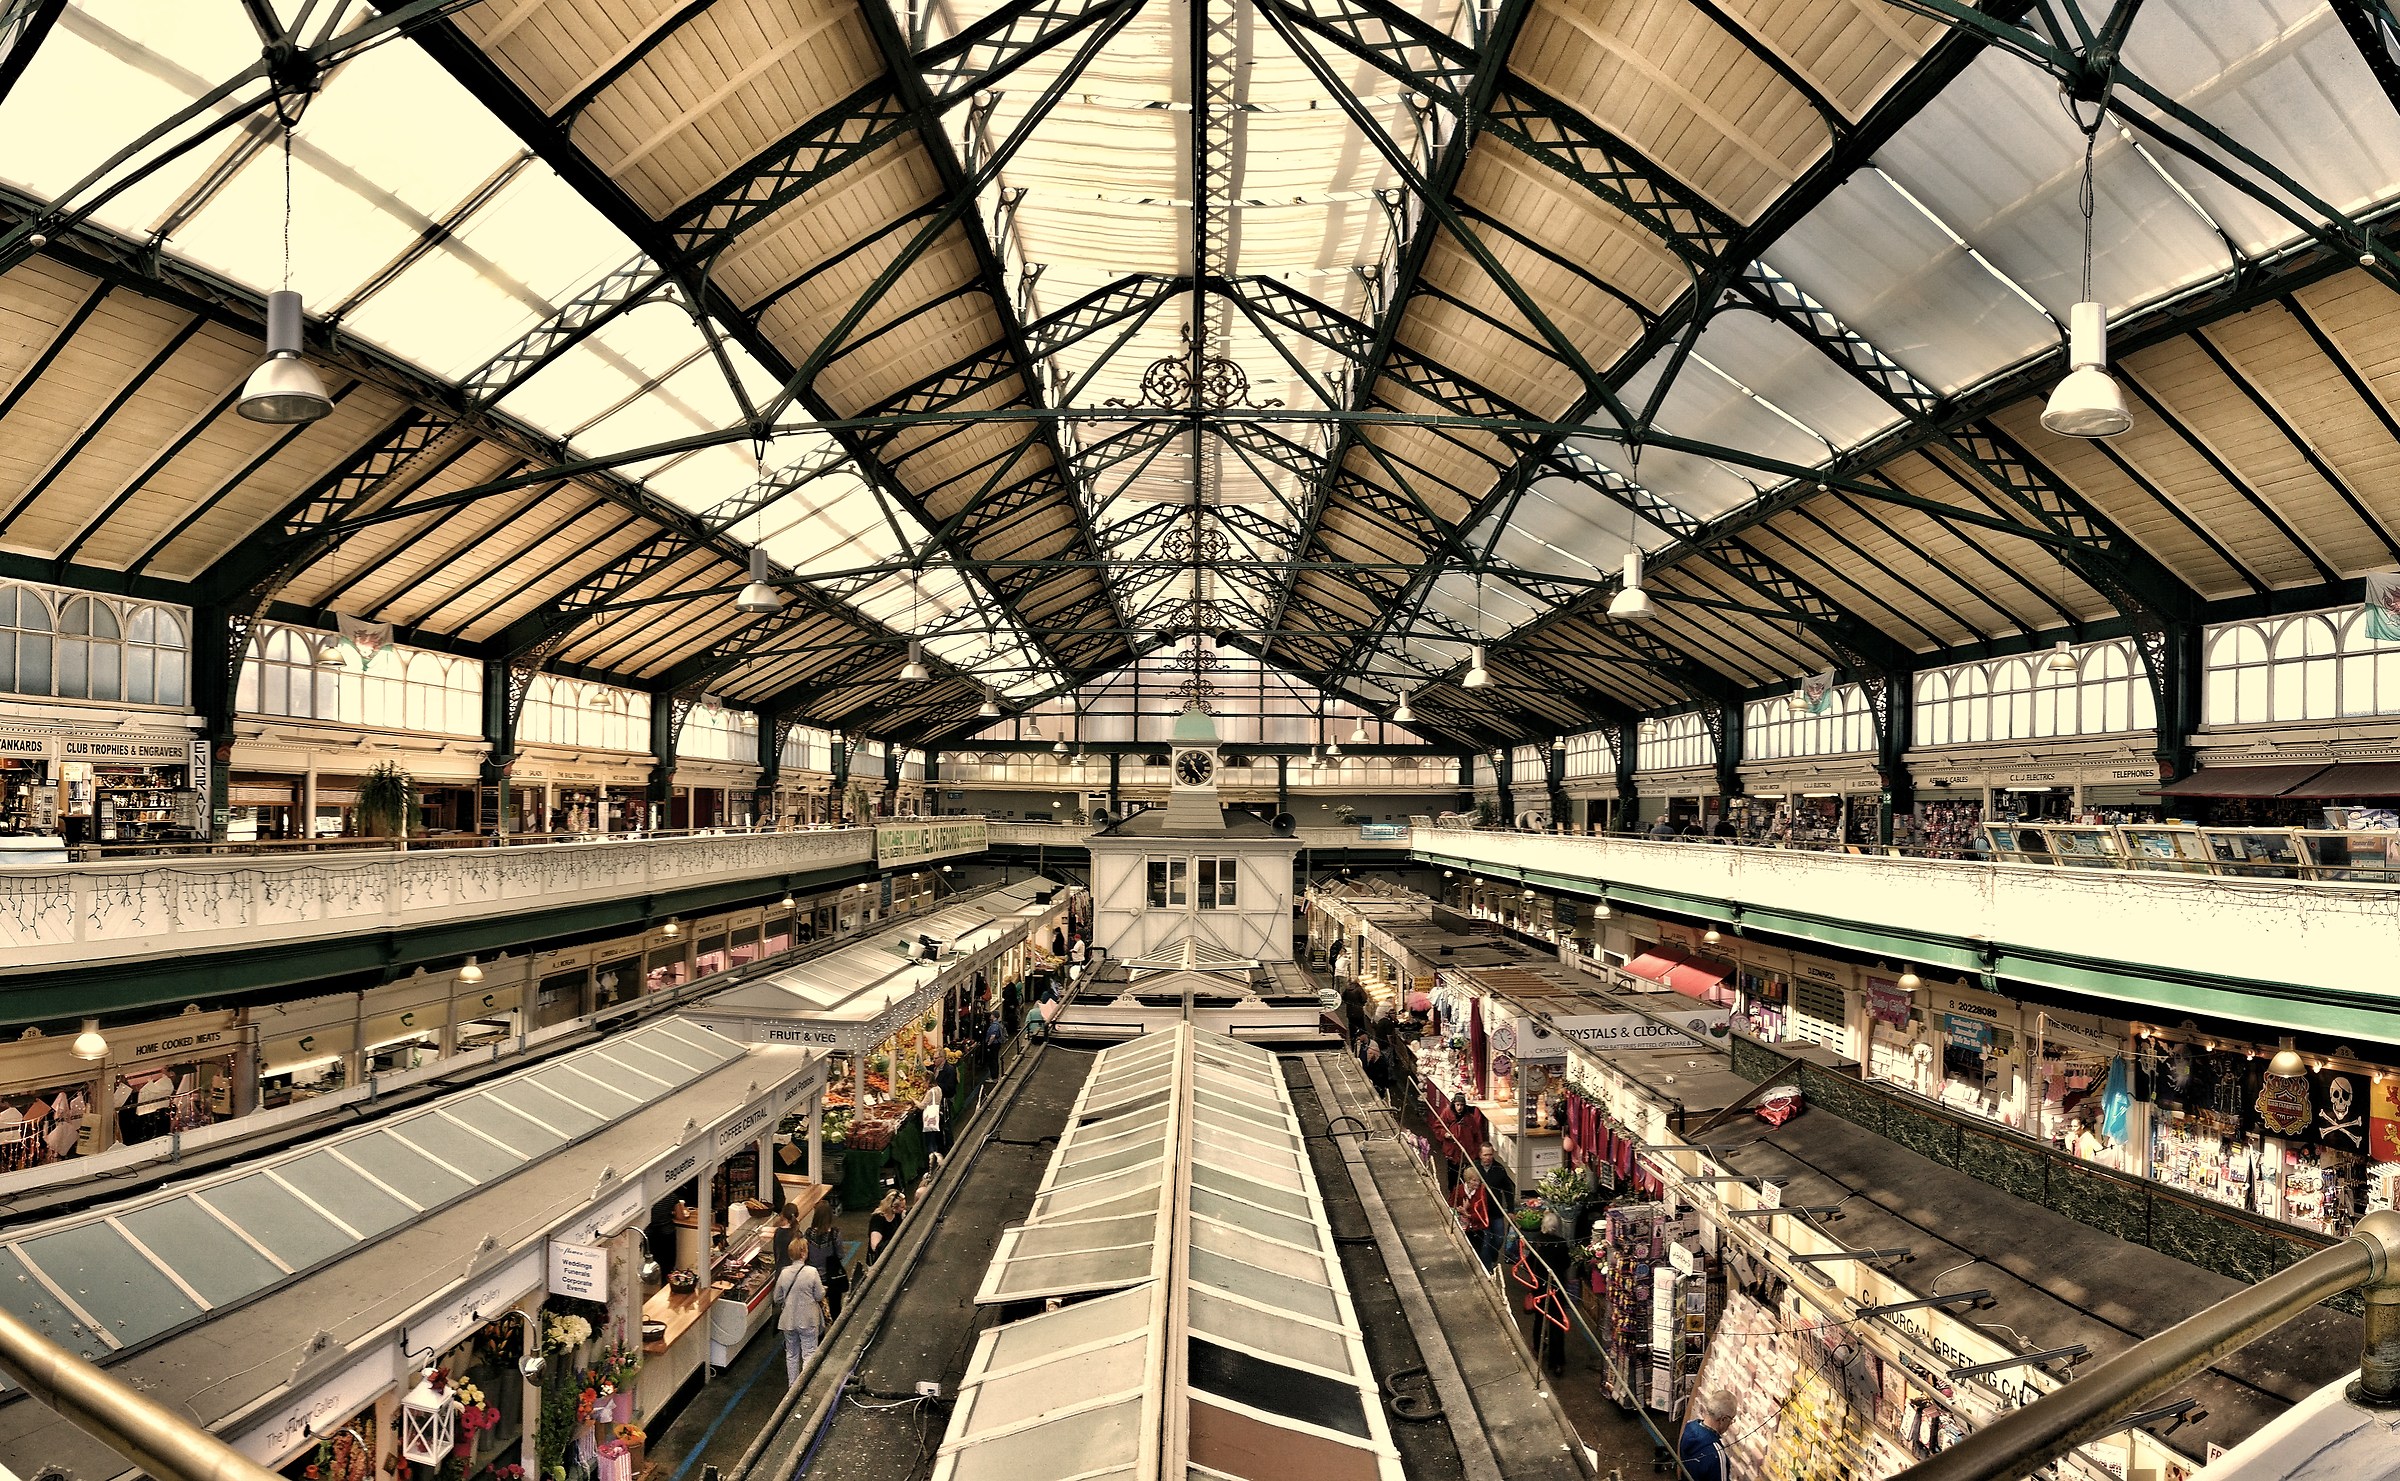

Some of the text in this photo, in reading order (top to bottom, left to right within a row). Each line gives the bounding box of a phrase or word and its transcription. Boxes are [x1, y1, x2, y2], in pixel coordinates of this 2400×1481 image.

[66, 742, 183, 758] CLUB TROPHIES & ENGRAVERS
[2026, 773, 2055, 781] ELECTRICS
[2112, 769, 2154, 779] TELEPHONES
[194, 741, 207, 840] ENGRAVIN
[2047, 1018, 2061, 1029] THE
[769, 1030, 837, 1043] FRUIT & VEG
[1620, 1026, 1630, 1038] &
[1633, 1025, 1680, 1037] CLOCKS
[135, 1031, 221, 1056] HOME COOKED MEATS
[784, 1075, 816, 1102] Jacket Potatoes
[719, 1106, 768, 1146] COFFEE CENTRAL
[664, 1155, 696, 1183] Baguettes
[562, 1258, 593, 1270] Weddings
[563, 1267, 591, 1278] Funerals
[561, 1276, 593, 1287] Corporate
[566, 1284, 588, 1294] Events
[1933, 1337, 1998, 1389] GREETG
